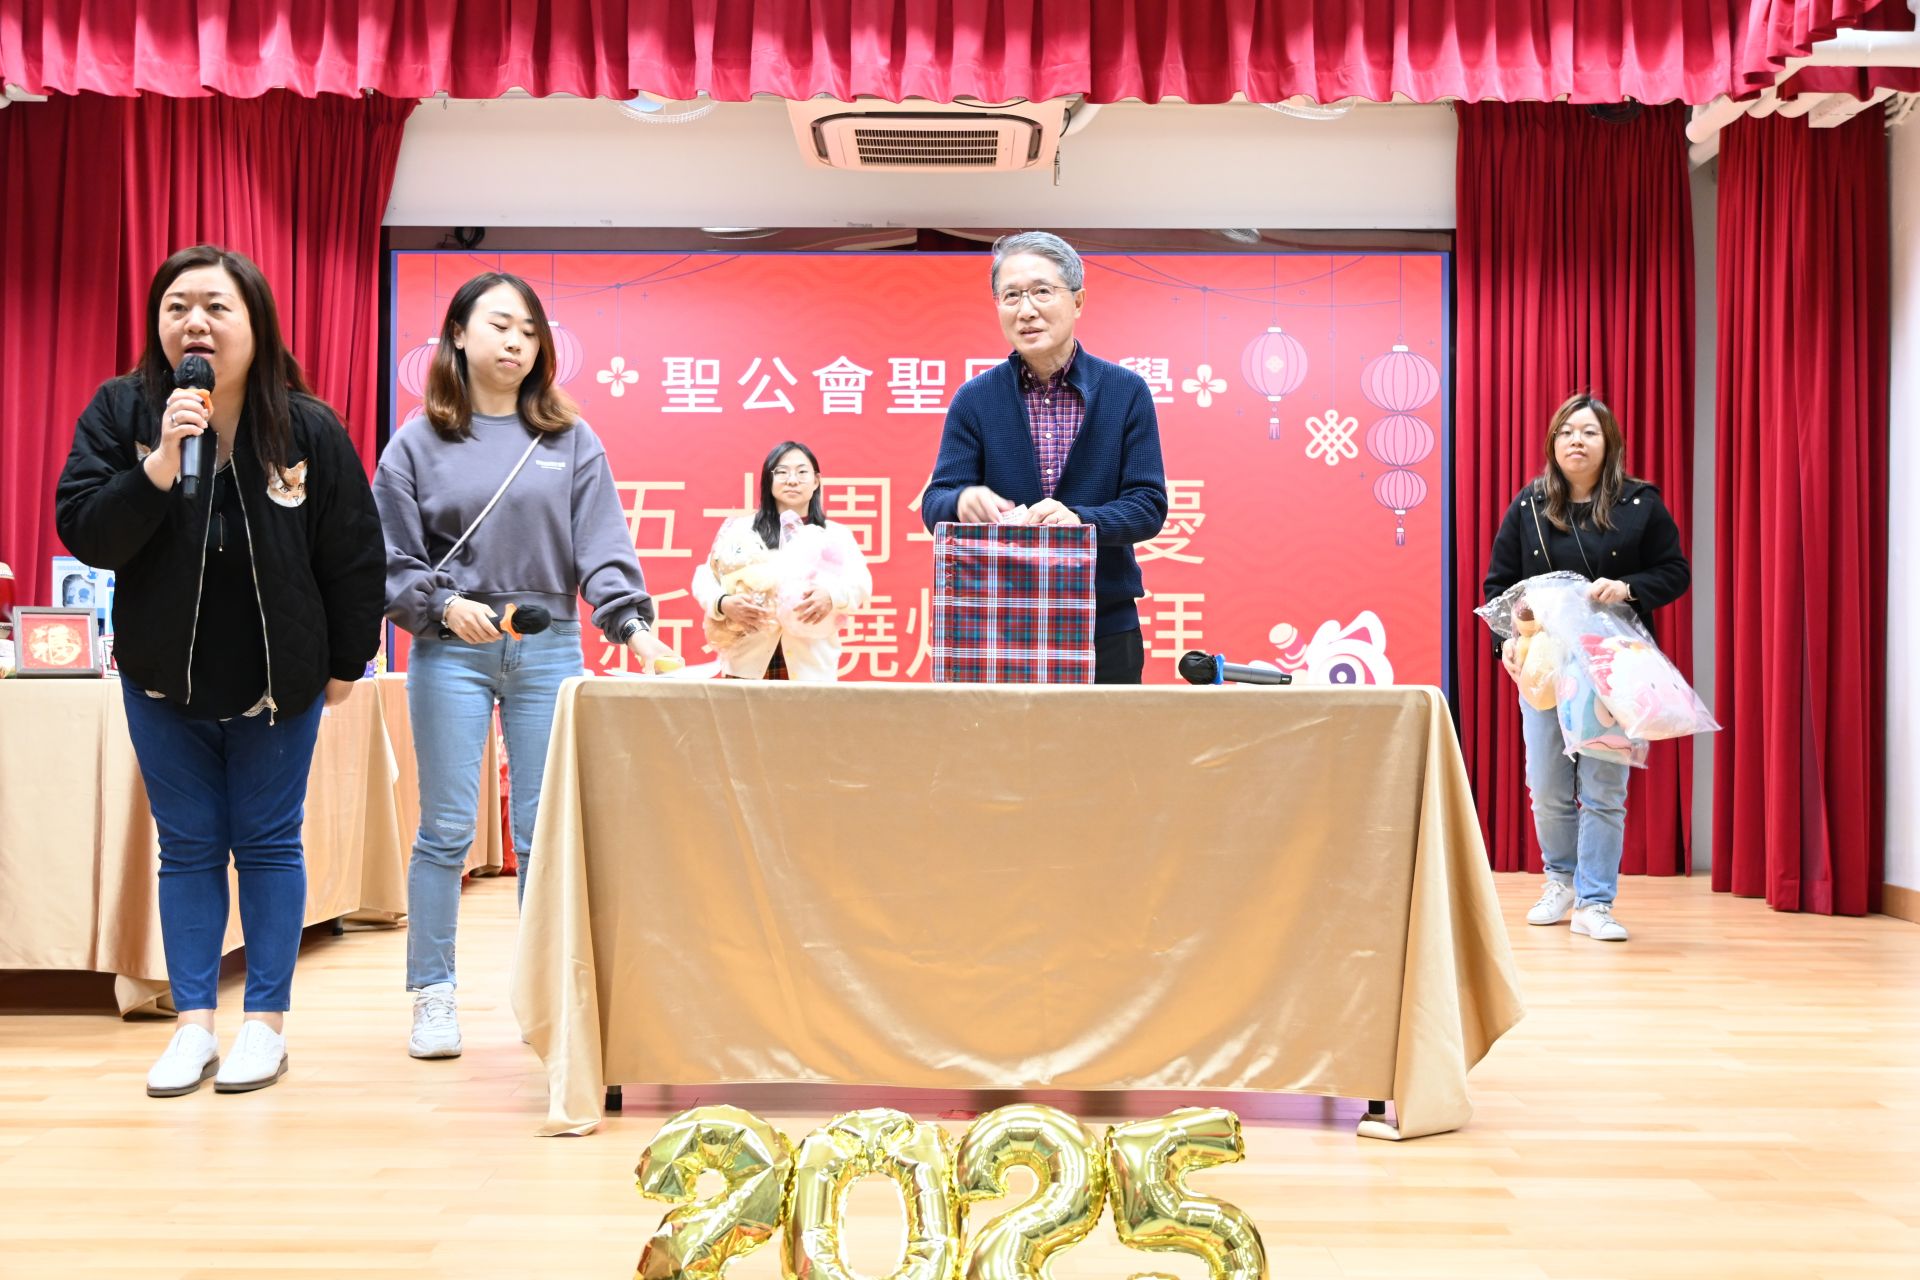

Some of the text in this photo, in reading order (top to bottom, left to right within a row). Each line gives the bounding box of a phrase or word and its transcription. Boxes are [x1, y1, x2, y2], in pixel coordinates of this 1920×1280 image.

[661, 356, 1174, 414] 聖公會聖學
[634, 1104, 1269, 1280] 2025
